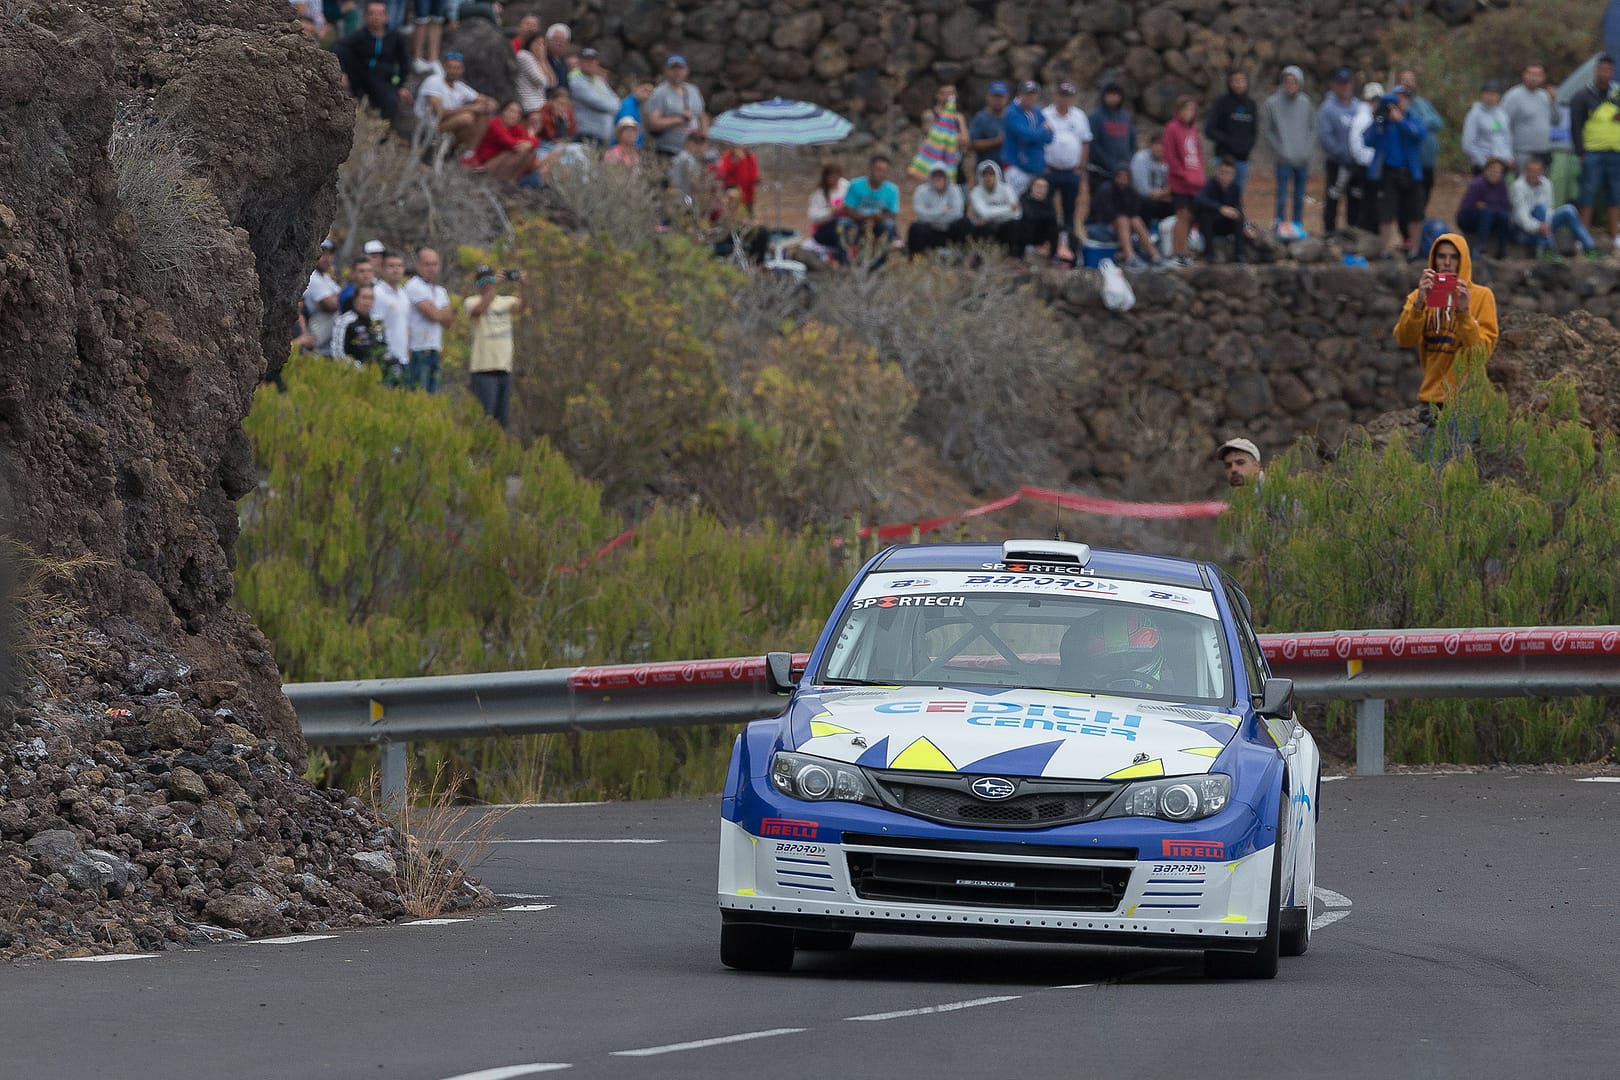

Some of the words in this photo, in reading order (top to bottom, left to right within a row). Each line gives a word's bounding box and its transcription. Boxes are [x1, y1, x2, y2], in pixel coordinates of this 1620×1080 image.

[980, 562, 1095, 576] SPORTECH
[851, 596, 966, 610] SPORTECH
[761, 817, 819, 838] PIRELLI
[1162, 839, 1225, 858] PIRELLI
